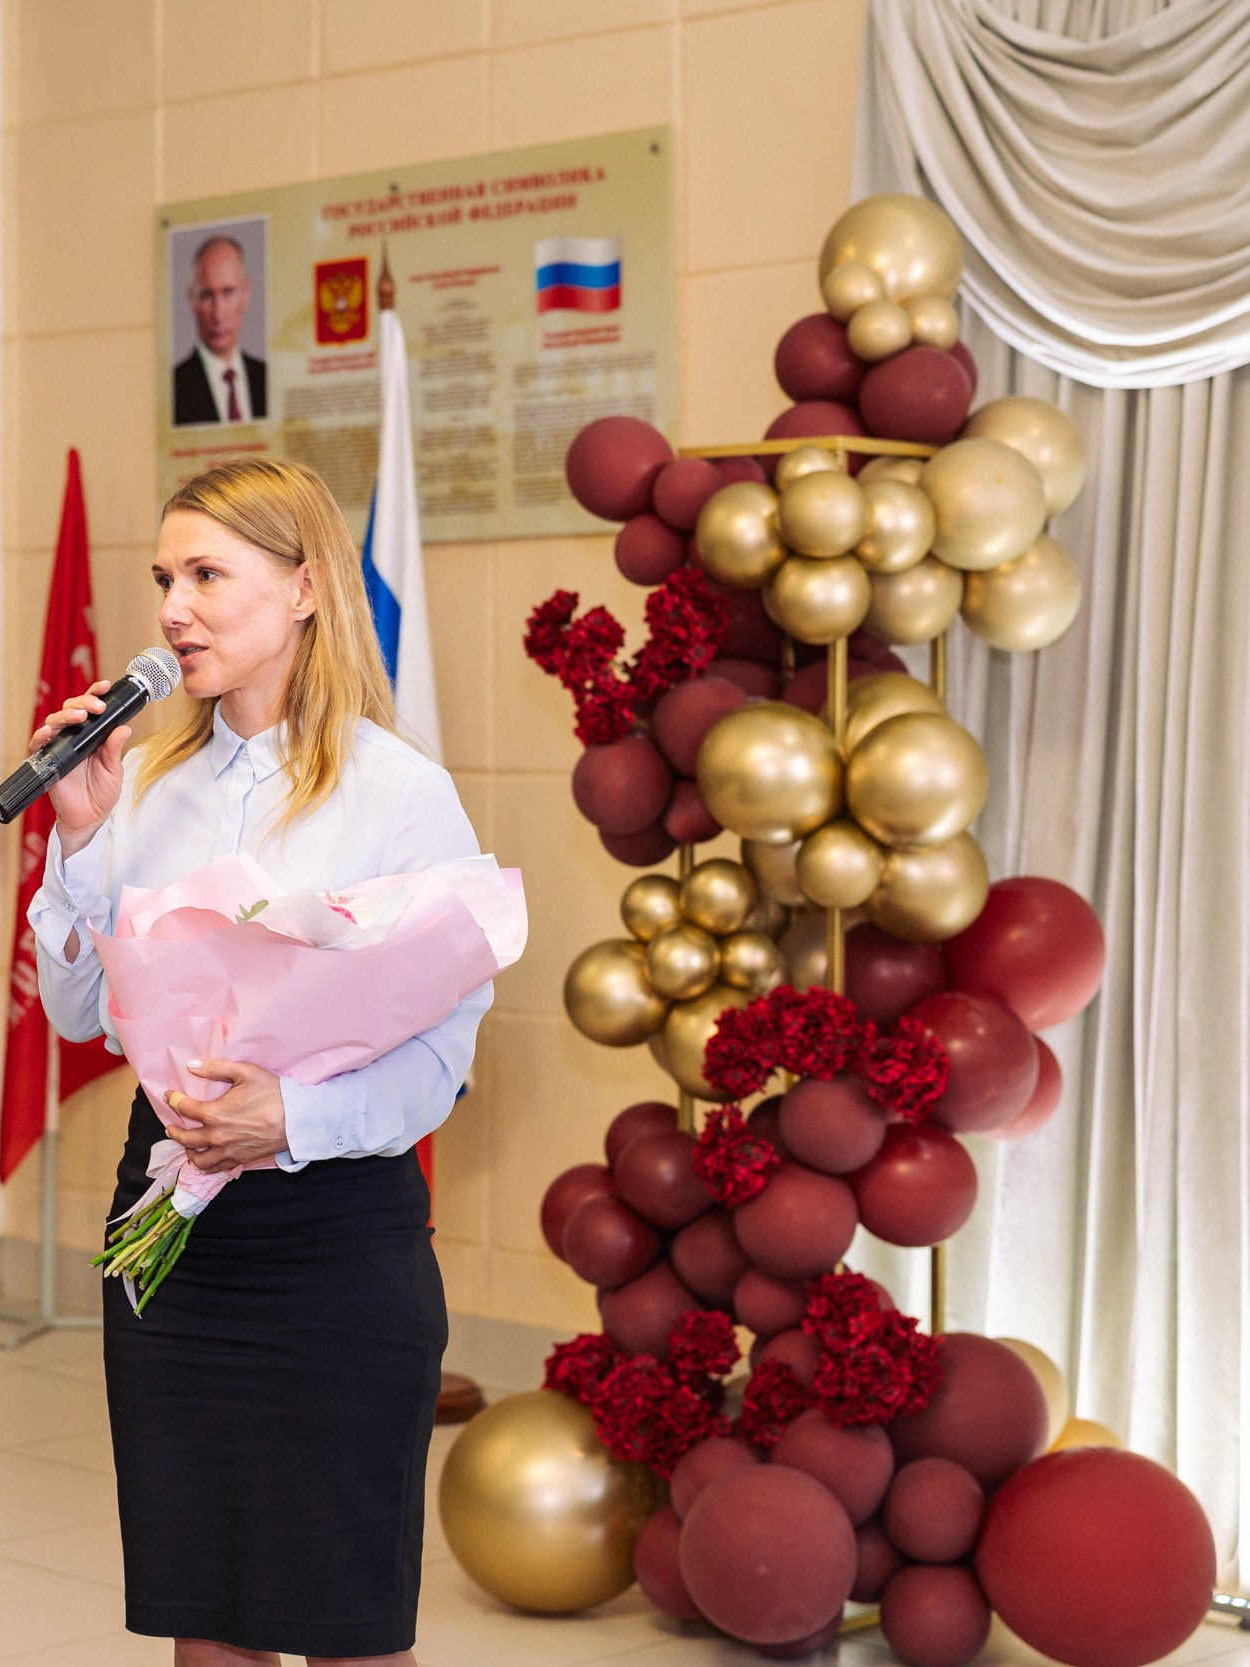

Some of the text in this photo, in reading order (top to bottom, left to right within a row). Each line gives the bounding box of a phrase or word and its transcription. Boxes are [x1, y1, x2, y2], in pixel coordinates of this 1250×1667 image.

[322, 166, 606, 221] ГОСУДАРСТВЕННАЯ СИМВОЛИКА
[347, 192, 579, 239] РОССИЙСКОЙ ФЕДЕРАЦИИ
